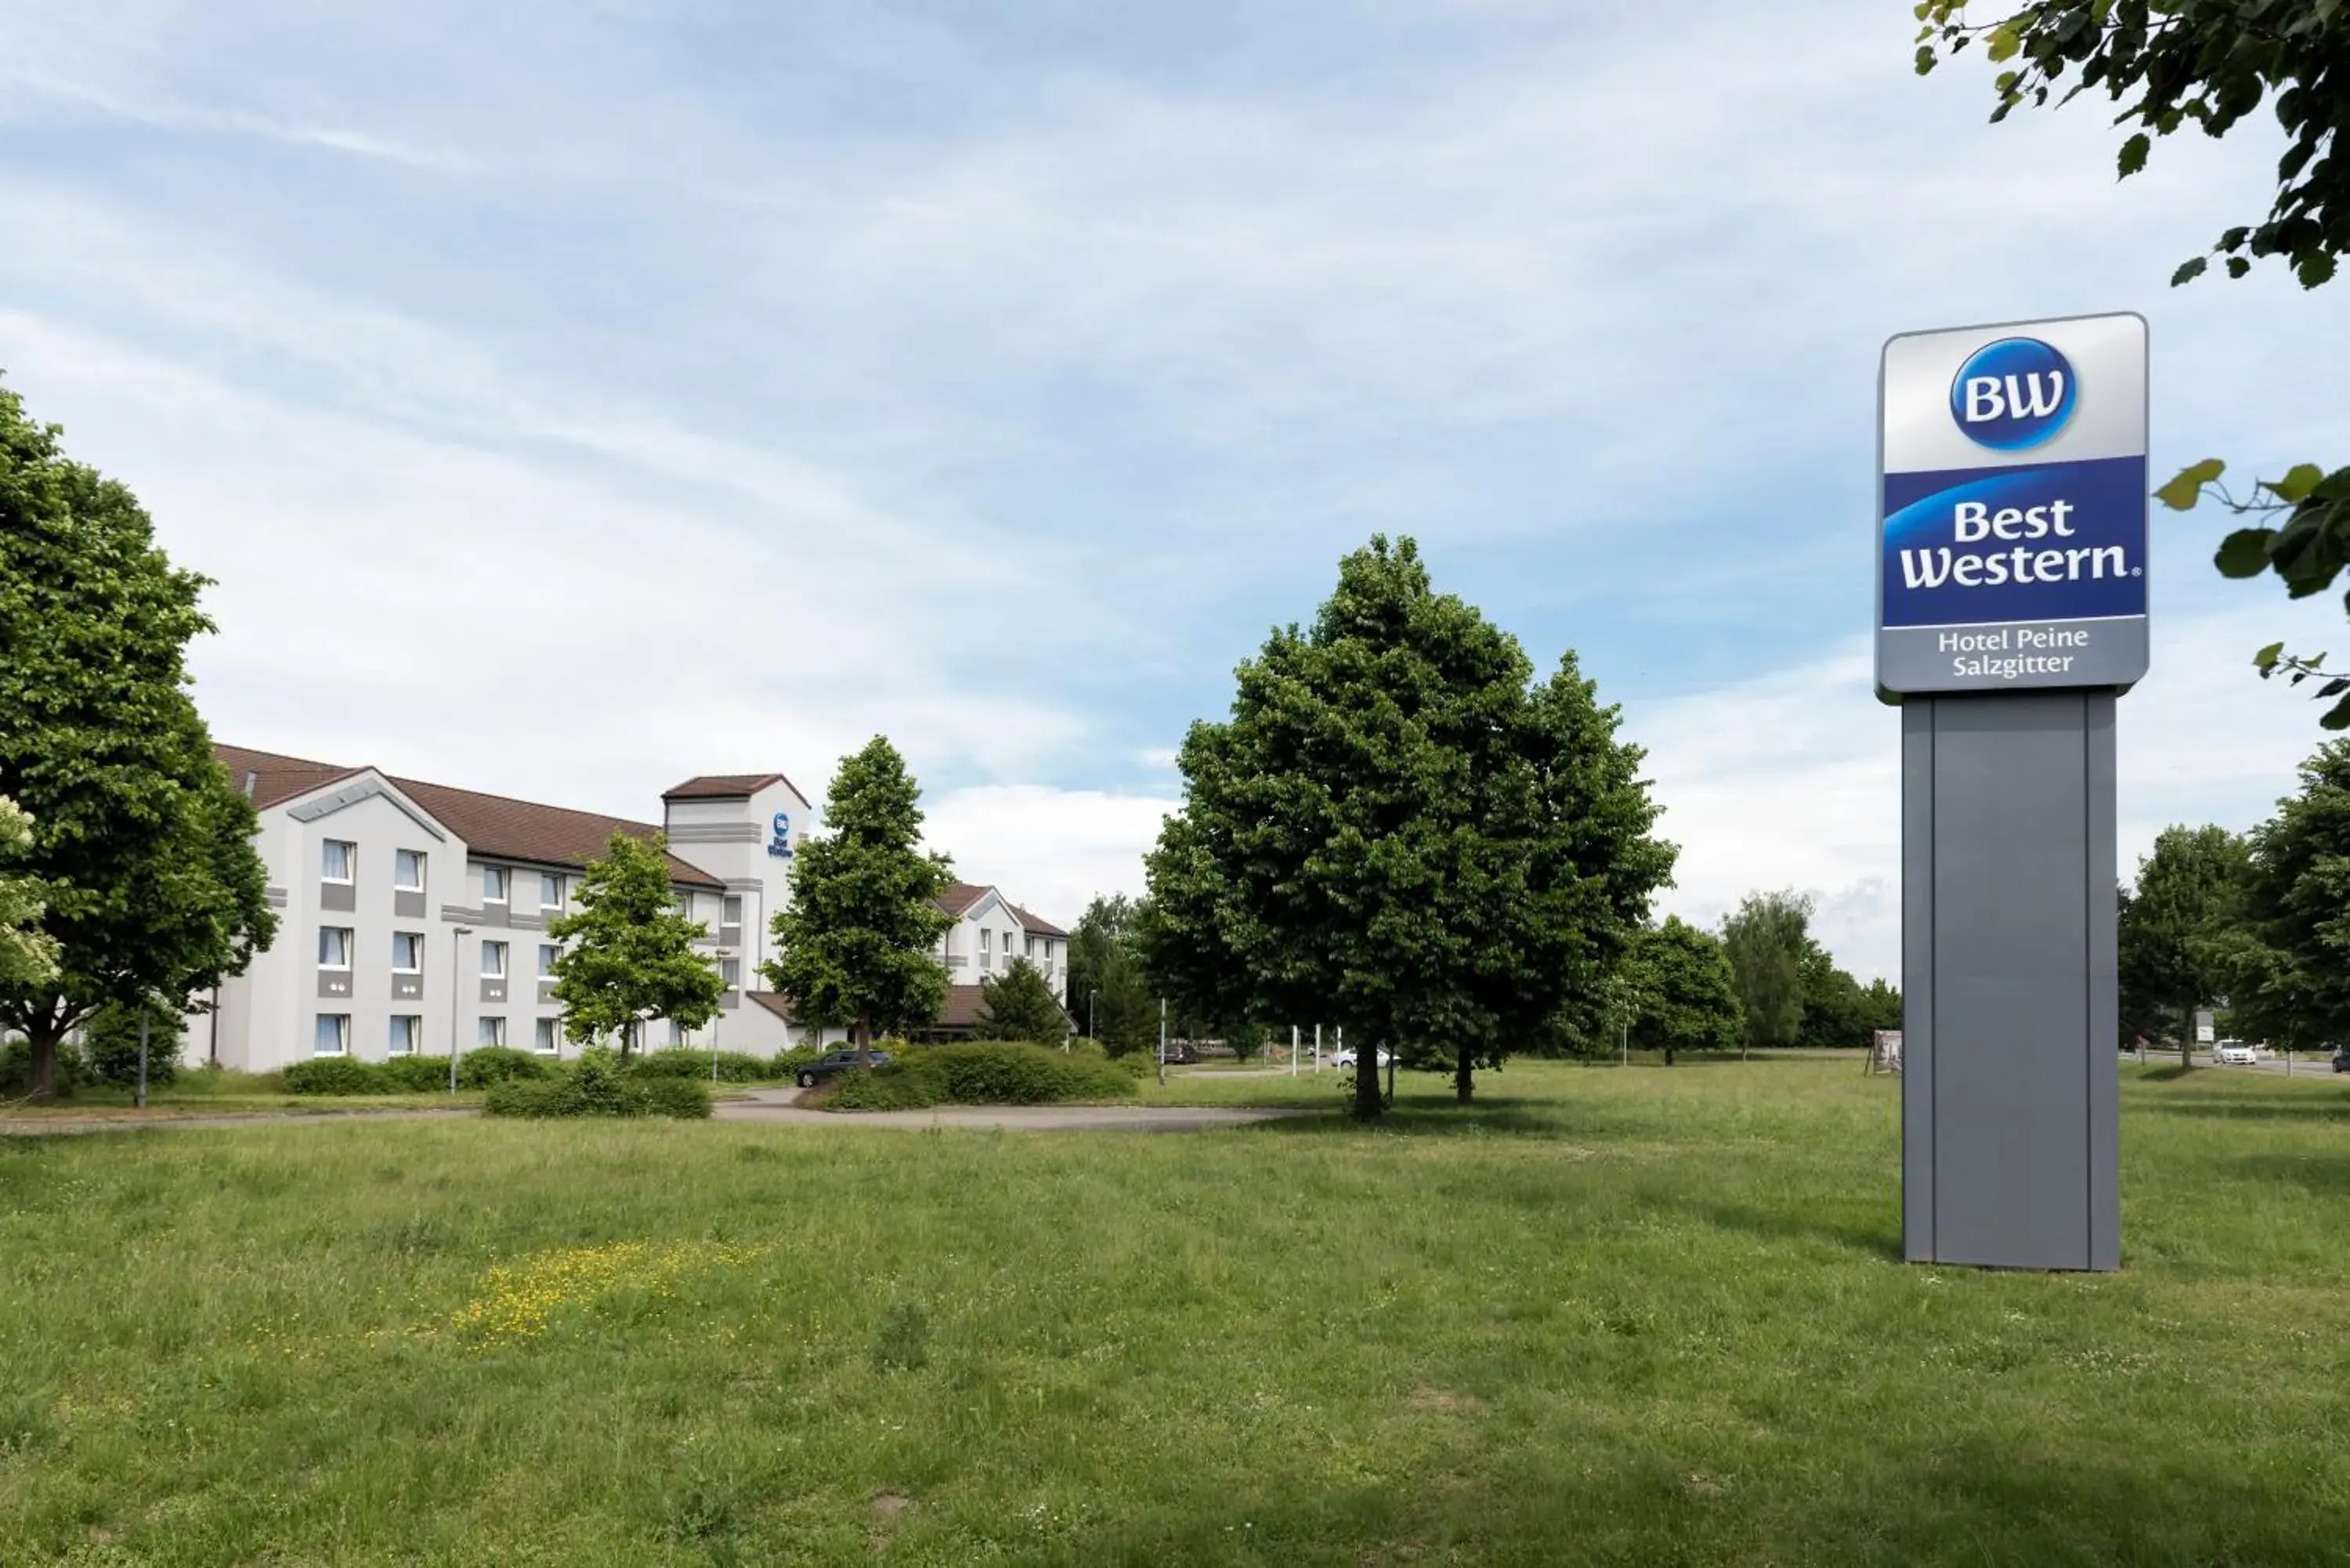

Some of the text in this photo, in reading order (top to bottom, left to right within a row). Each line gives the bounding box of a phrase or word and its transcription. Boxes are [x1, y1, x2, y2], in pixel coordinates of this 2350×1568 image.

[1965, 370, 2064, 422] BW
[1954, 499, 2075, 542] Best
[1939, 628, 2089, 652] Hotel Peine
[1953, 653, 2073, 679] Salzgitter
